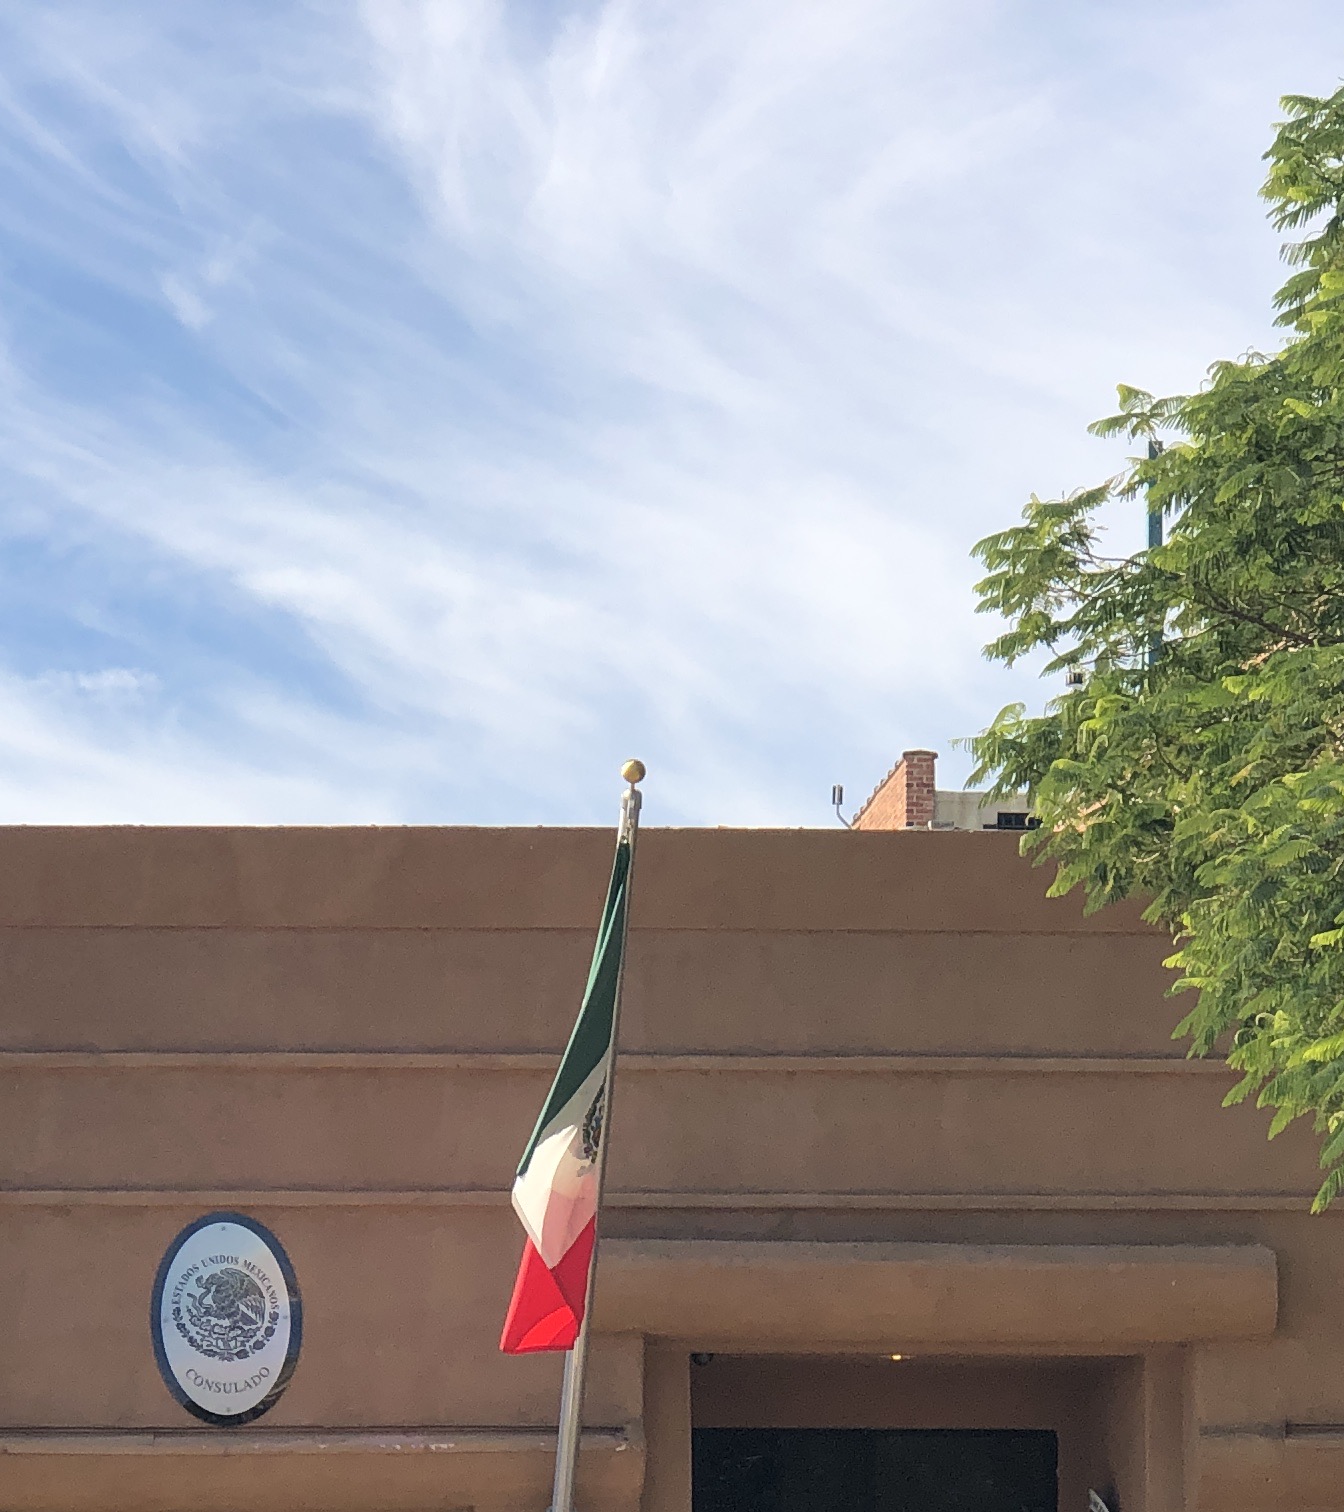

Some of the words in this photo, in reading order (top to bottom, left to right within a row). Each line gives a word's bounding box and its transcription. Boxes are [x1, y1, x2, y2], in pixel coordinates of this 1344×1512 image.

[172, 1263, 200, 1304] ESTADOS
[201, 1254, 240, 1268] UNIDOS
[243, 1258, 280, 1310] MEXICANOS
[185, 1366, 270, 1394] CONSULADO
